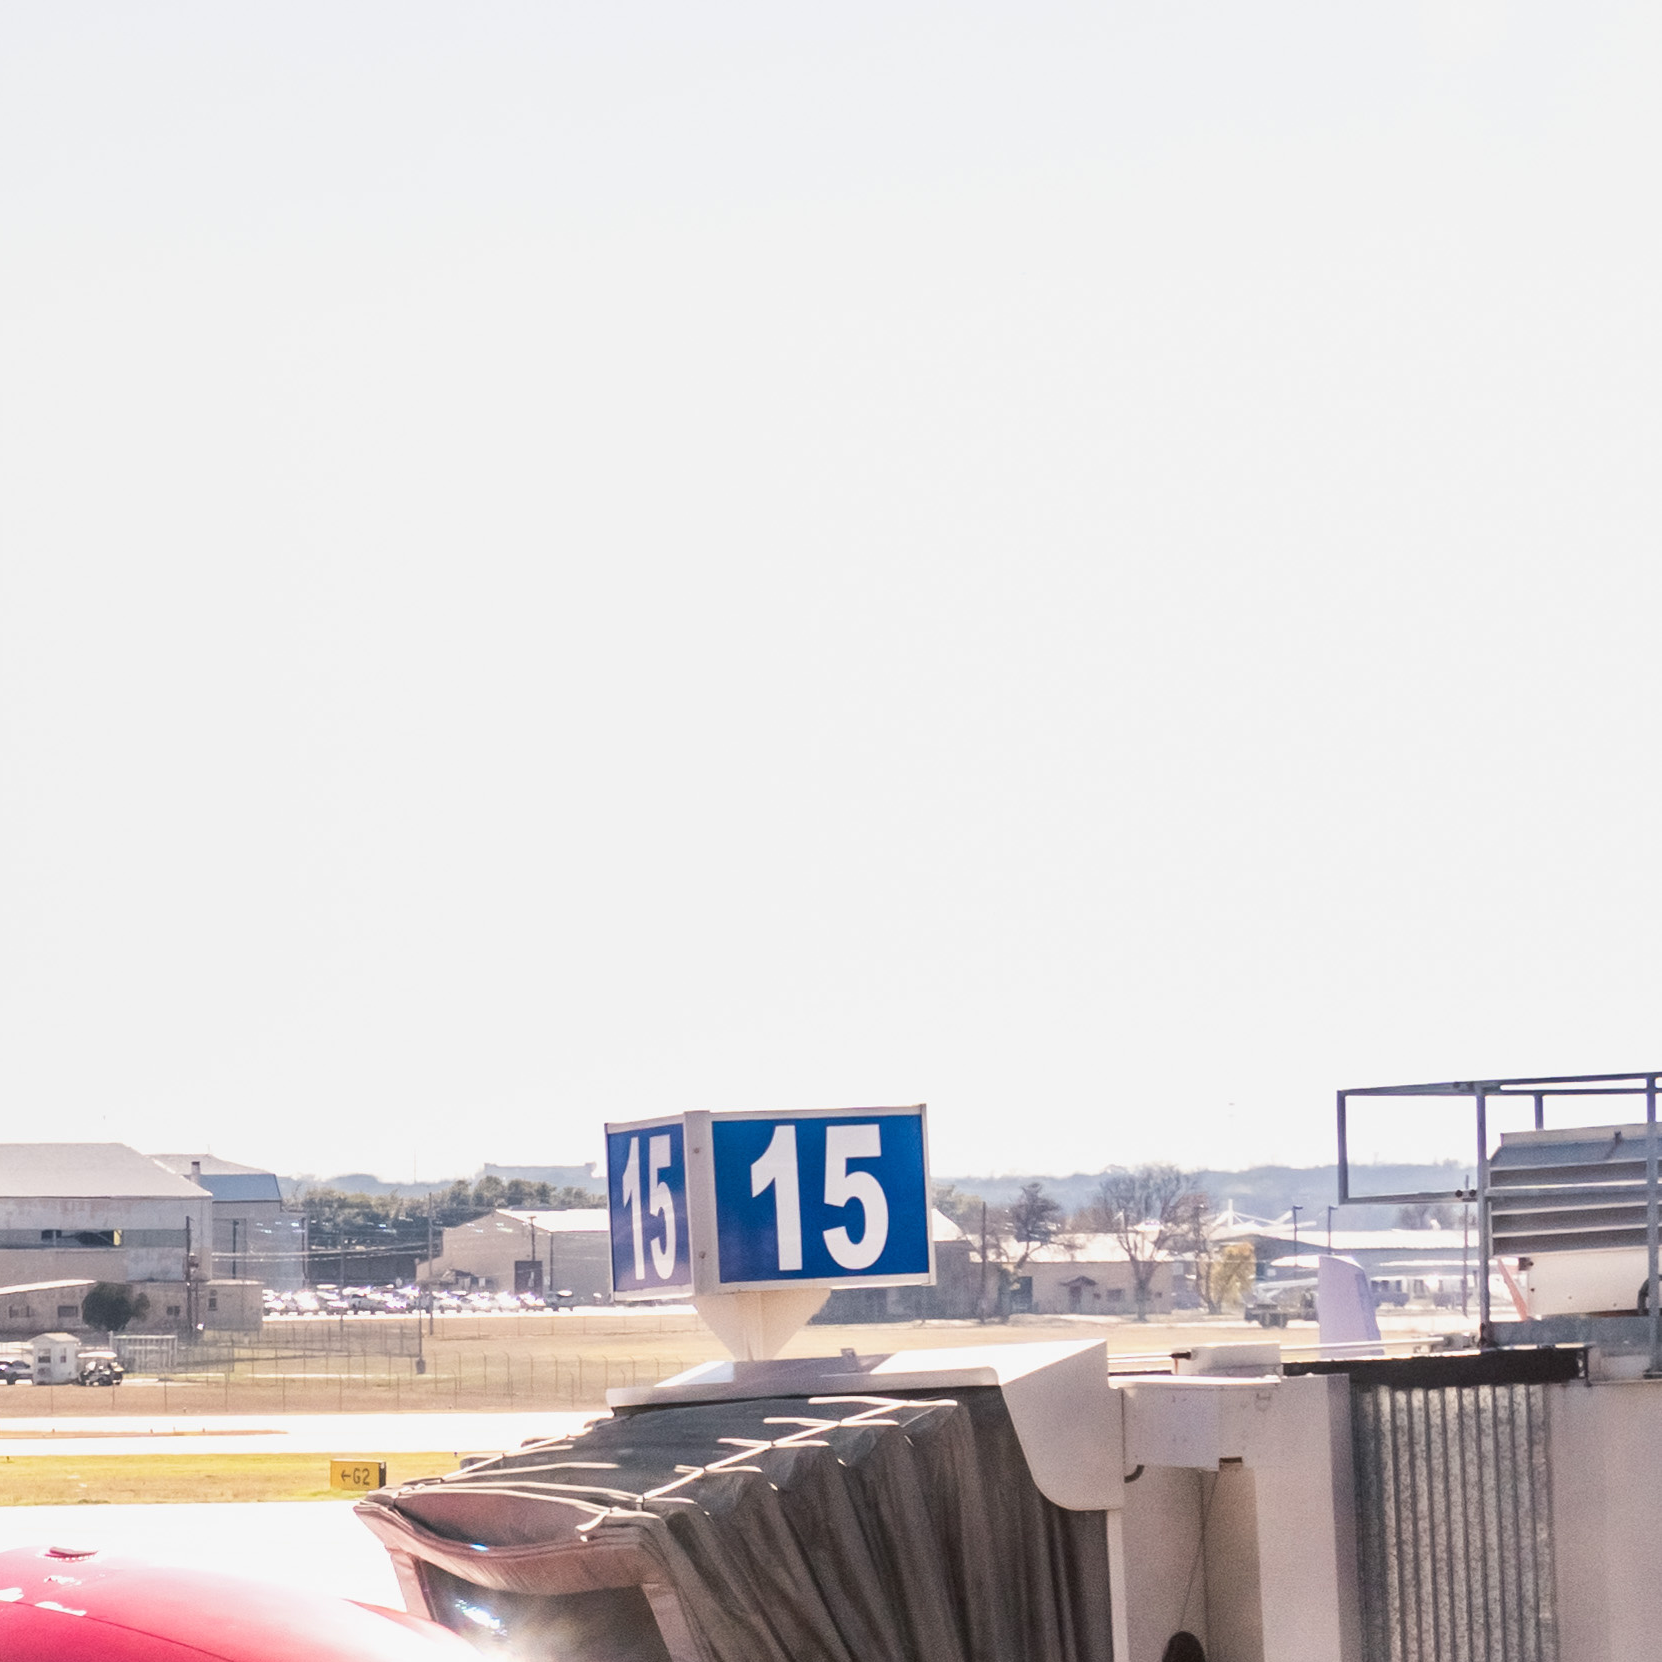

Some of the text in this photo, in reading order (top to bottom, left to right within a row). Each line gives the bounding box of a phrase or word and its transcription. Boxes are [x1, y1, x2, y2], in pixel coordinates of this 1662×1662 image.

[622, 1134, 677, 1281] 15
[750, 1124, 889, 1271] 15
[353, 1468, 370, 1485] G2
